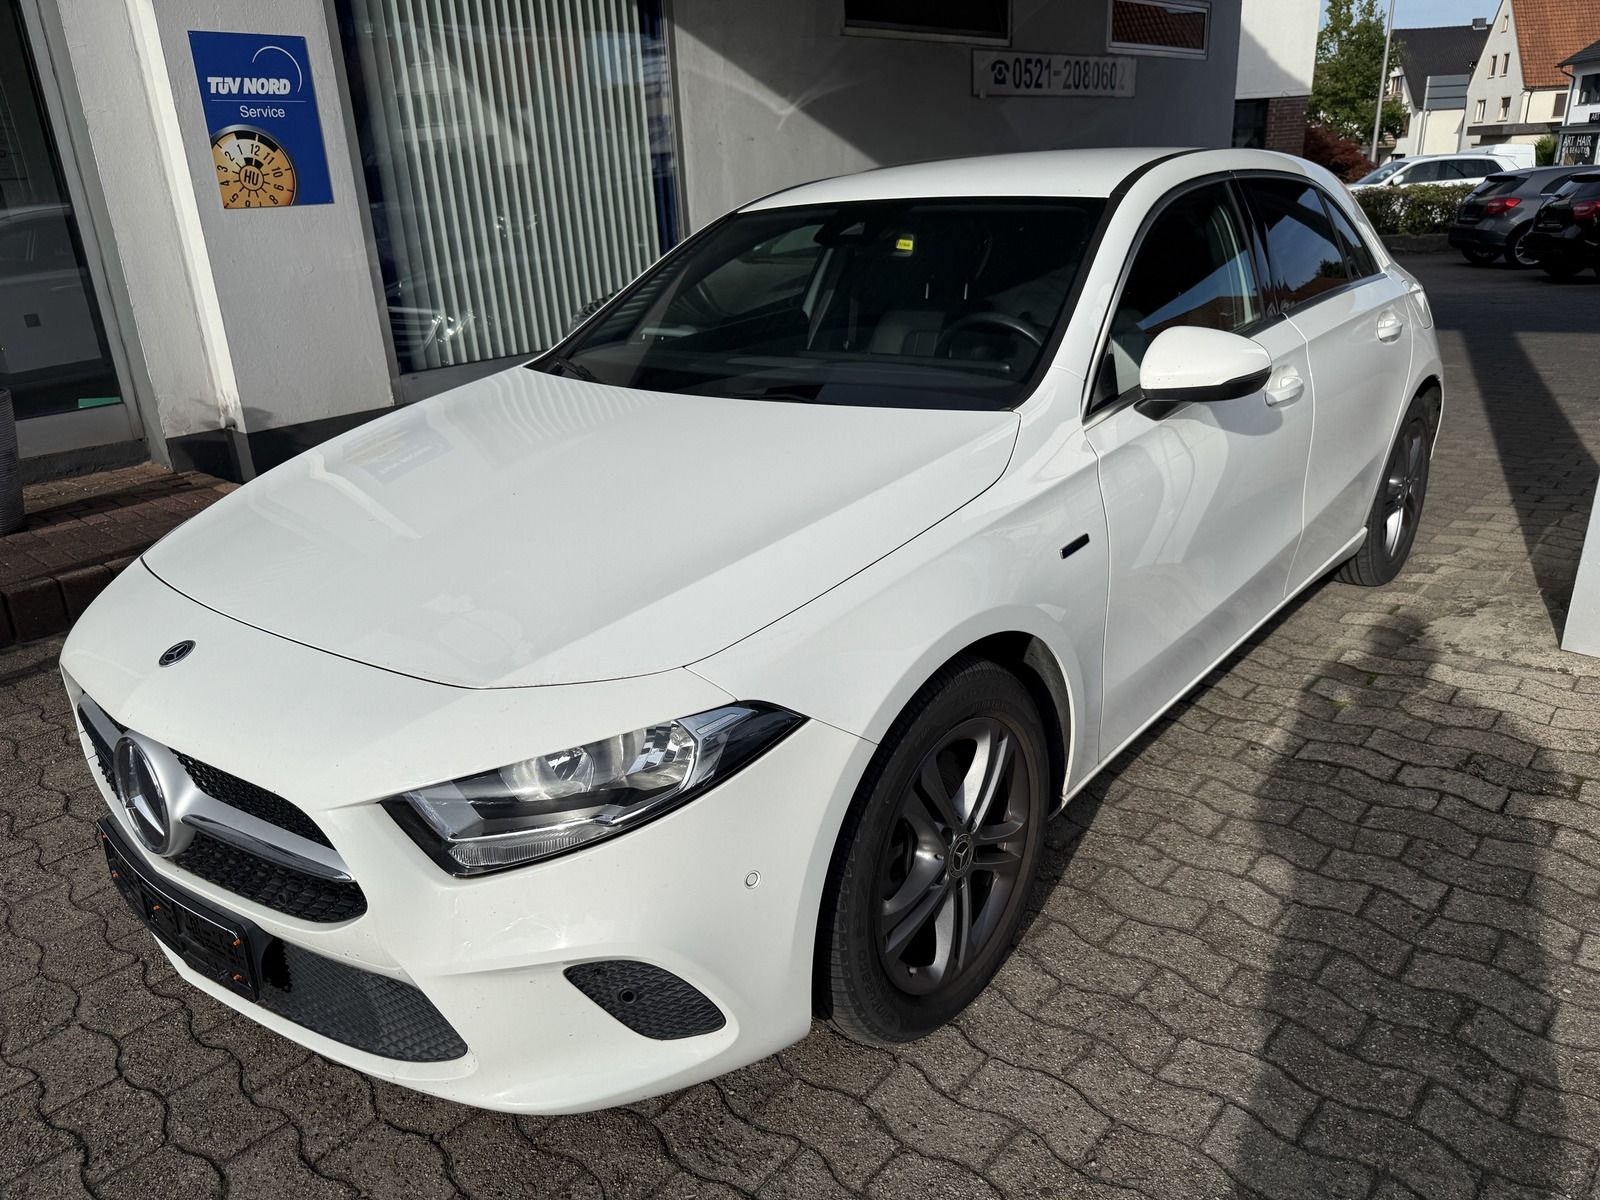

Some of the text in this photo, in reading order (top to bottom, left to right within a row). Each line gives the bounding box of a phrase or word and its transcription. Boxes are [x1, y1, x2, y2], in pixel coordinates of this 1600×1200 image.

[207, 76, 291, 95] TÜV NORD
[240, 105, 286, 118] Service
[1563, 136, 1592, 146] ART HAIR
[236, 143, 243, 155] 1
[250, 143, 261, 156] 12
[224, 151, 235, 162] 2
[263, 152, 275, 165] 11
[216, 165, 228, 173] 3
[271, 167, 283, 178] 10
[243, 169, 259, 186] HU
[273, 184, 284, 192] 9
[229, 193, 239, 203] 5
[269, 194, 279, 205] 8
